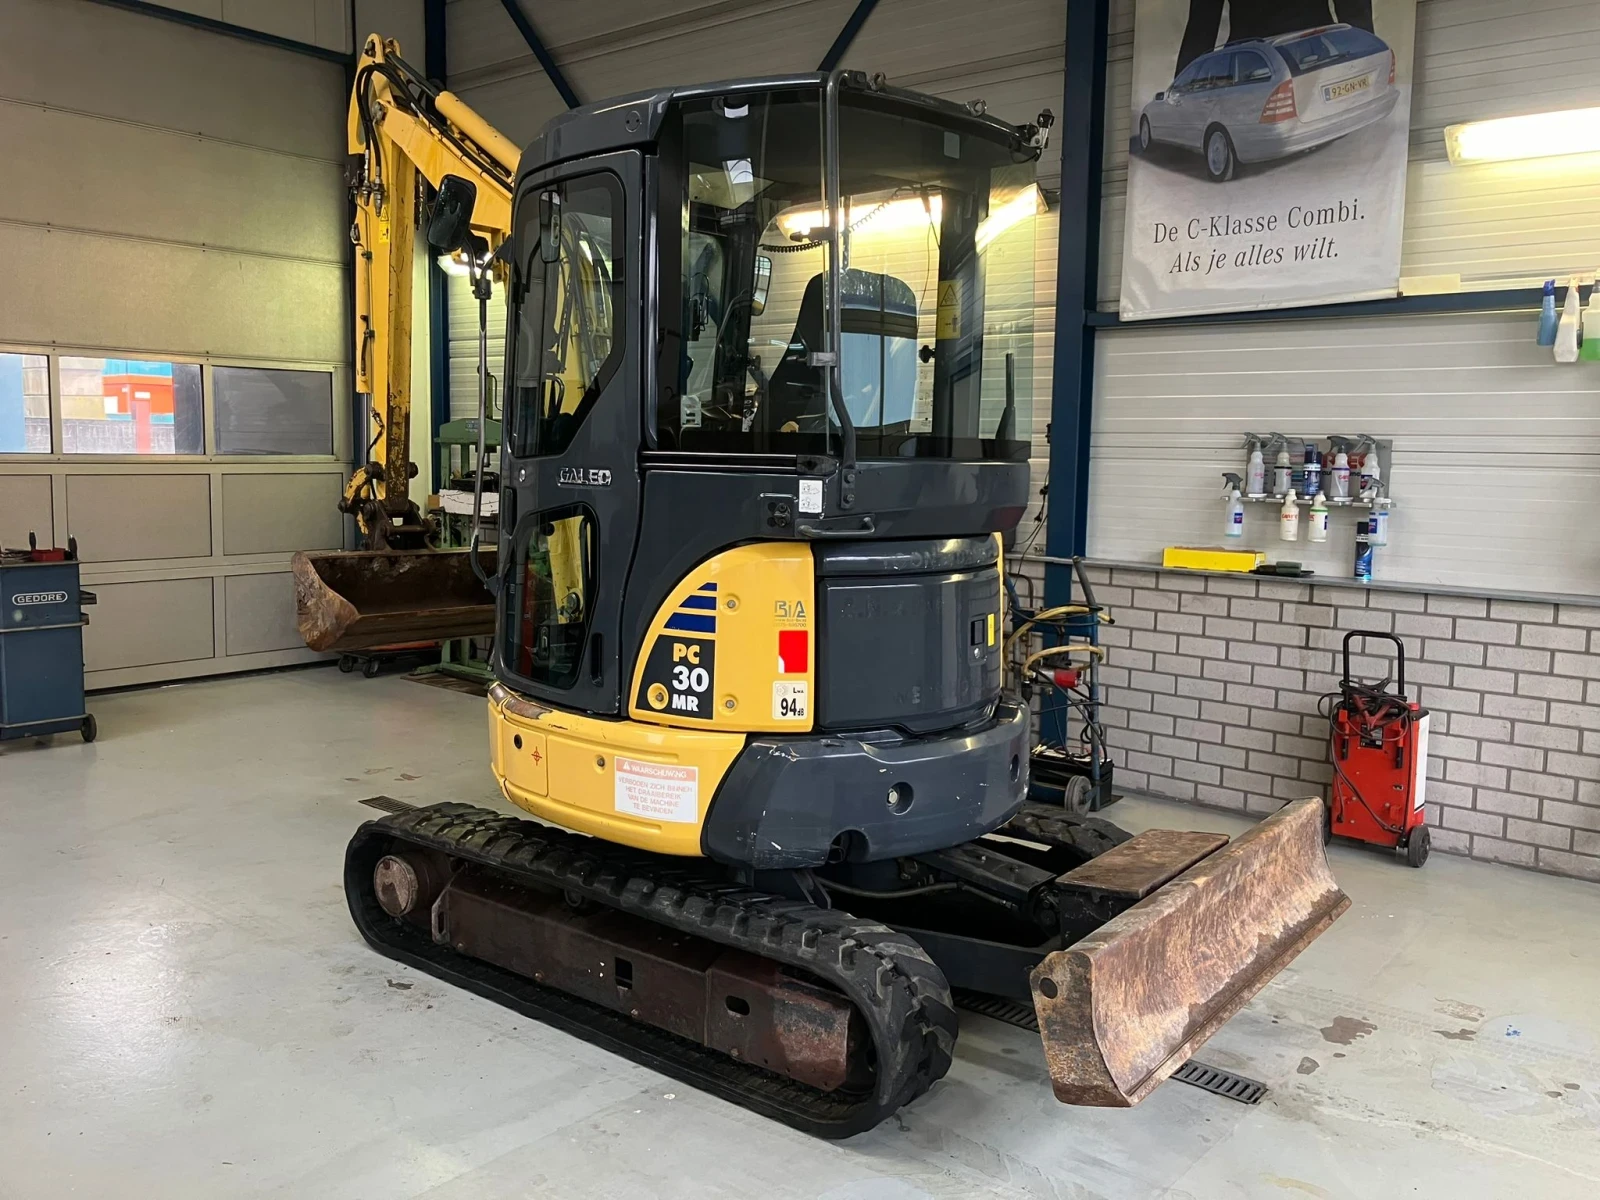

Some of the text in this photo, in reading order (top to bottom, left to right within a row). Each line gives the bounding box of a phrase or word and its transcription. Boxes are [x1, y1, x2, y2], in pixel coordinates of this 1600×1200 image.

[1153, 198, 1365, 243] De C-Klasse Combi.
[1169, 236, 1338, 275] Als je alles wilt.
[17, 593, 63, 604] GEDORE
[673, 643, 700, 665] PC
[672, 665, 709, 693] 30
[672, 693, 699, 712] MR
[780, 697, 797, 717] 94
[631, 765, 687, 778] WAARSCHUWING
[618, 776, 693, 793] VERBODEN ZICH BINNEN
[625, 785, 637, 793] HET
[628, 793, 639, 802] VAN
[650, 798, 680, 808] MACHINE
[633, 802, 673, 814] TE BEVINDEN
